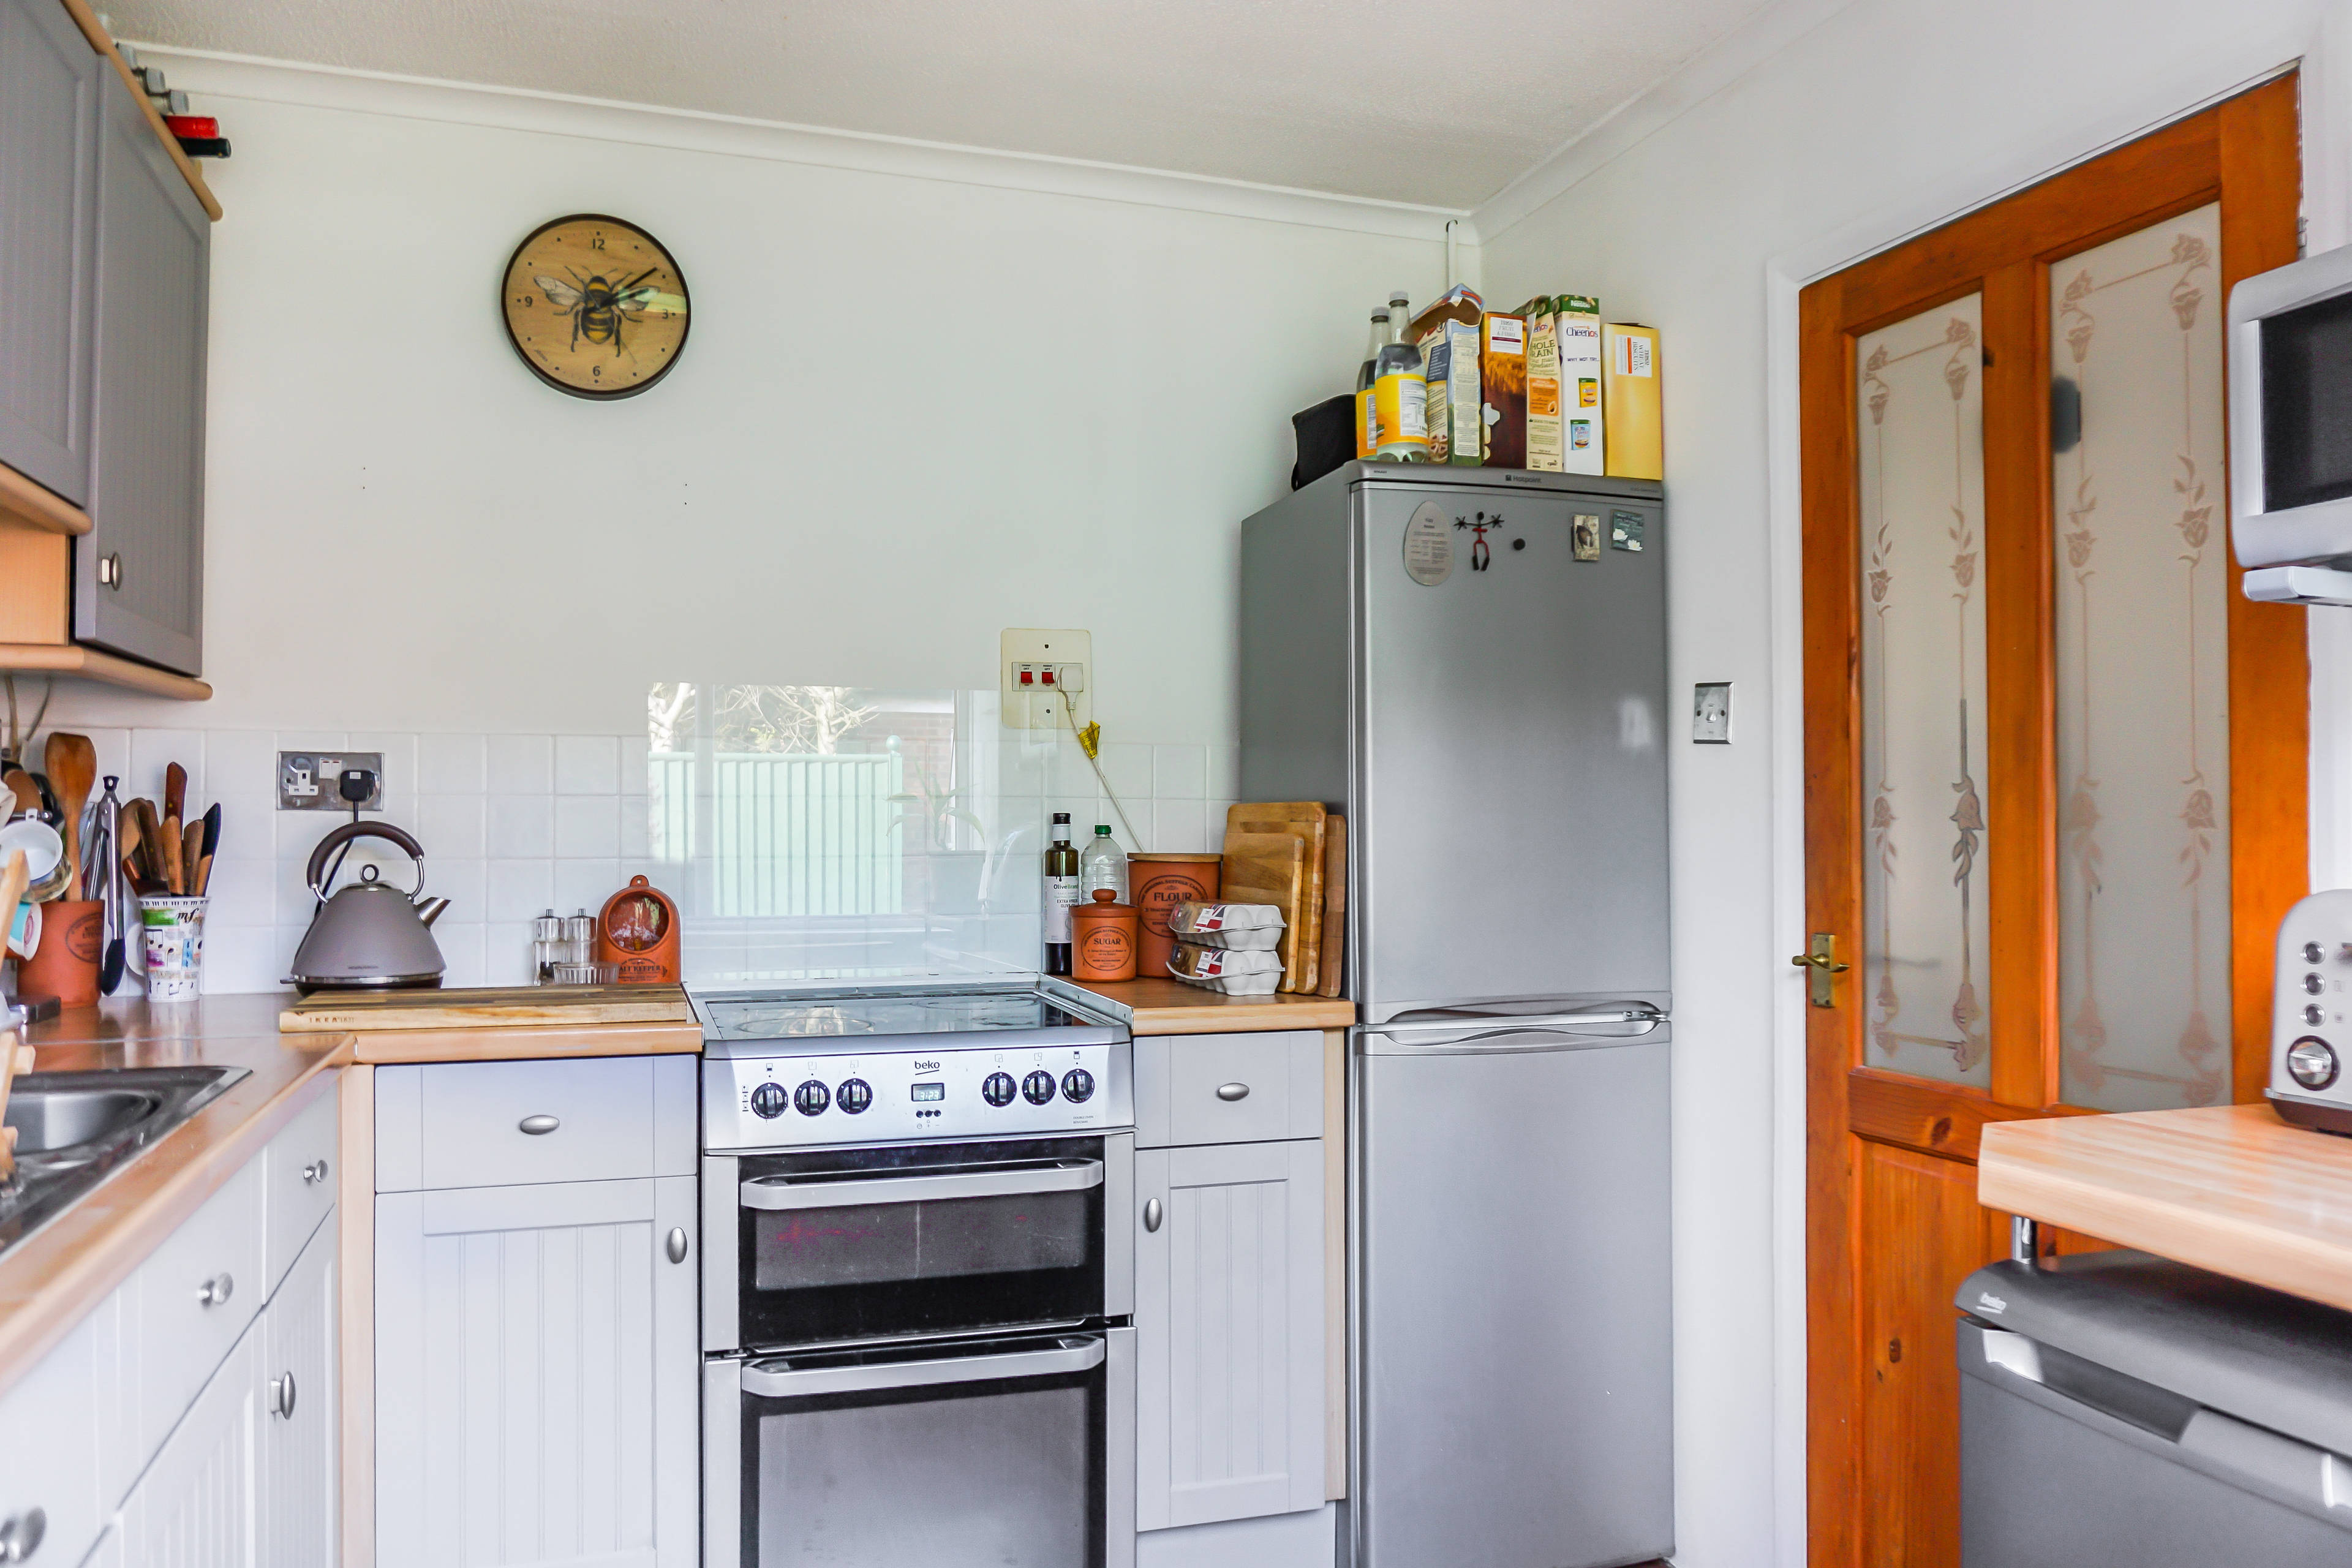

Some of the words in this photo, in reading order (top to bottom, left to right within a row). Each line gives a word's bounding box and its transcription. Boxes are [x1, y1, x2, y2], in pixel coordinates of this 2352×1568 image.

[592, 238, 605, 251] 12
[525, 296, 533, 307] 9
[662, 309, 669, 319] 3
[1566, 326, 1599, 338] Cheerios
[1532, 339, 1556, 350] HOLE
[1532, 347, 1554, 358] RAIN
[592, 365, 601, 377] 6
[1153, 892, 1193, 902] FLOUR
[1093, 937, 1121, 945] SUGAR
[914, 1060, 940, 1069] beko
